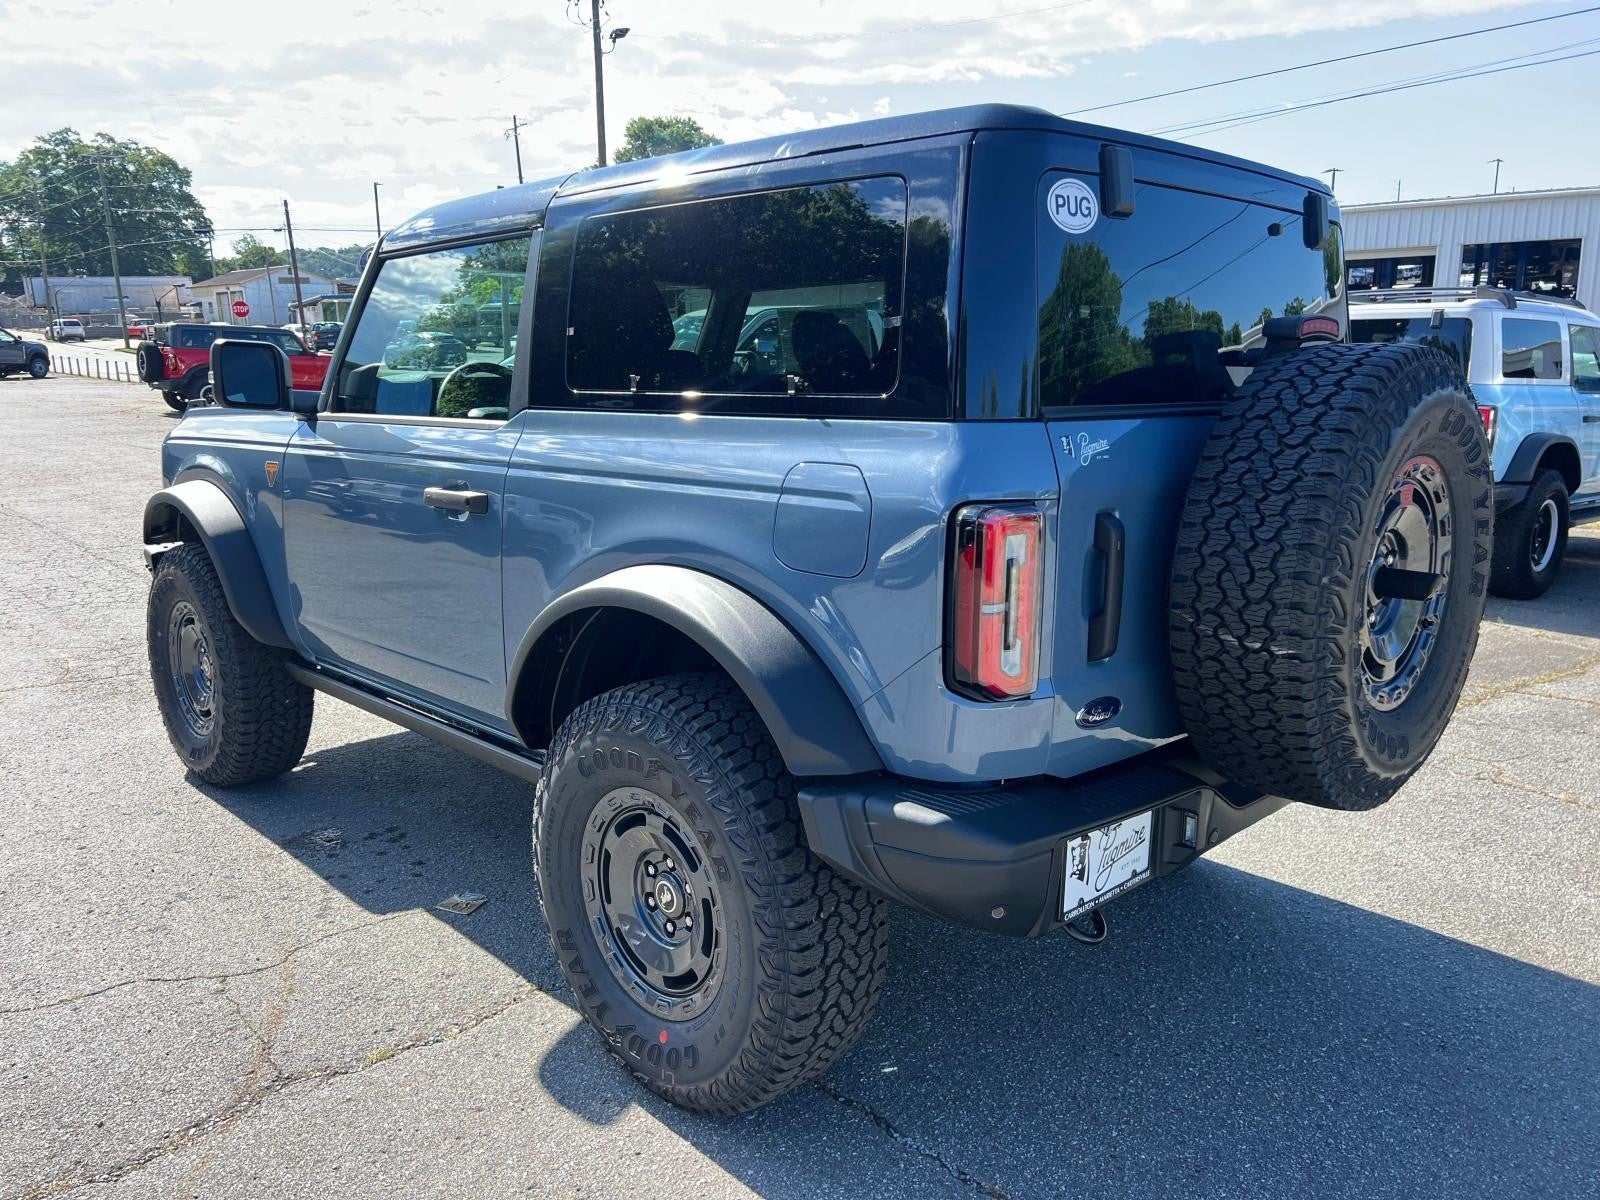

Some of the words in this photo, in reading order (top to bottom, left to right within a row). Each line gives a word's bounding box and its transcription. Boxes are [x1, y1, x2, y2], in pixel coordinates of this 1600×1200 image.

[1055, 193, 1092, 218] PUG
[234, 305, 249, 313] STOP
[1439, 407, 1491, 598] GOODYEAR
[577, 747, 732, 884] GOODYEAR
[1095, 824, 1146, 893] Pugmire
[1064, 901, 1095, 921] CARROLLTON
[556, 927, 700, 1070] GOODYEAR
